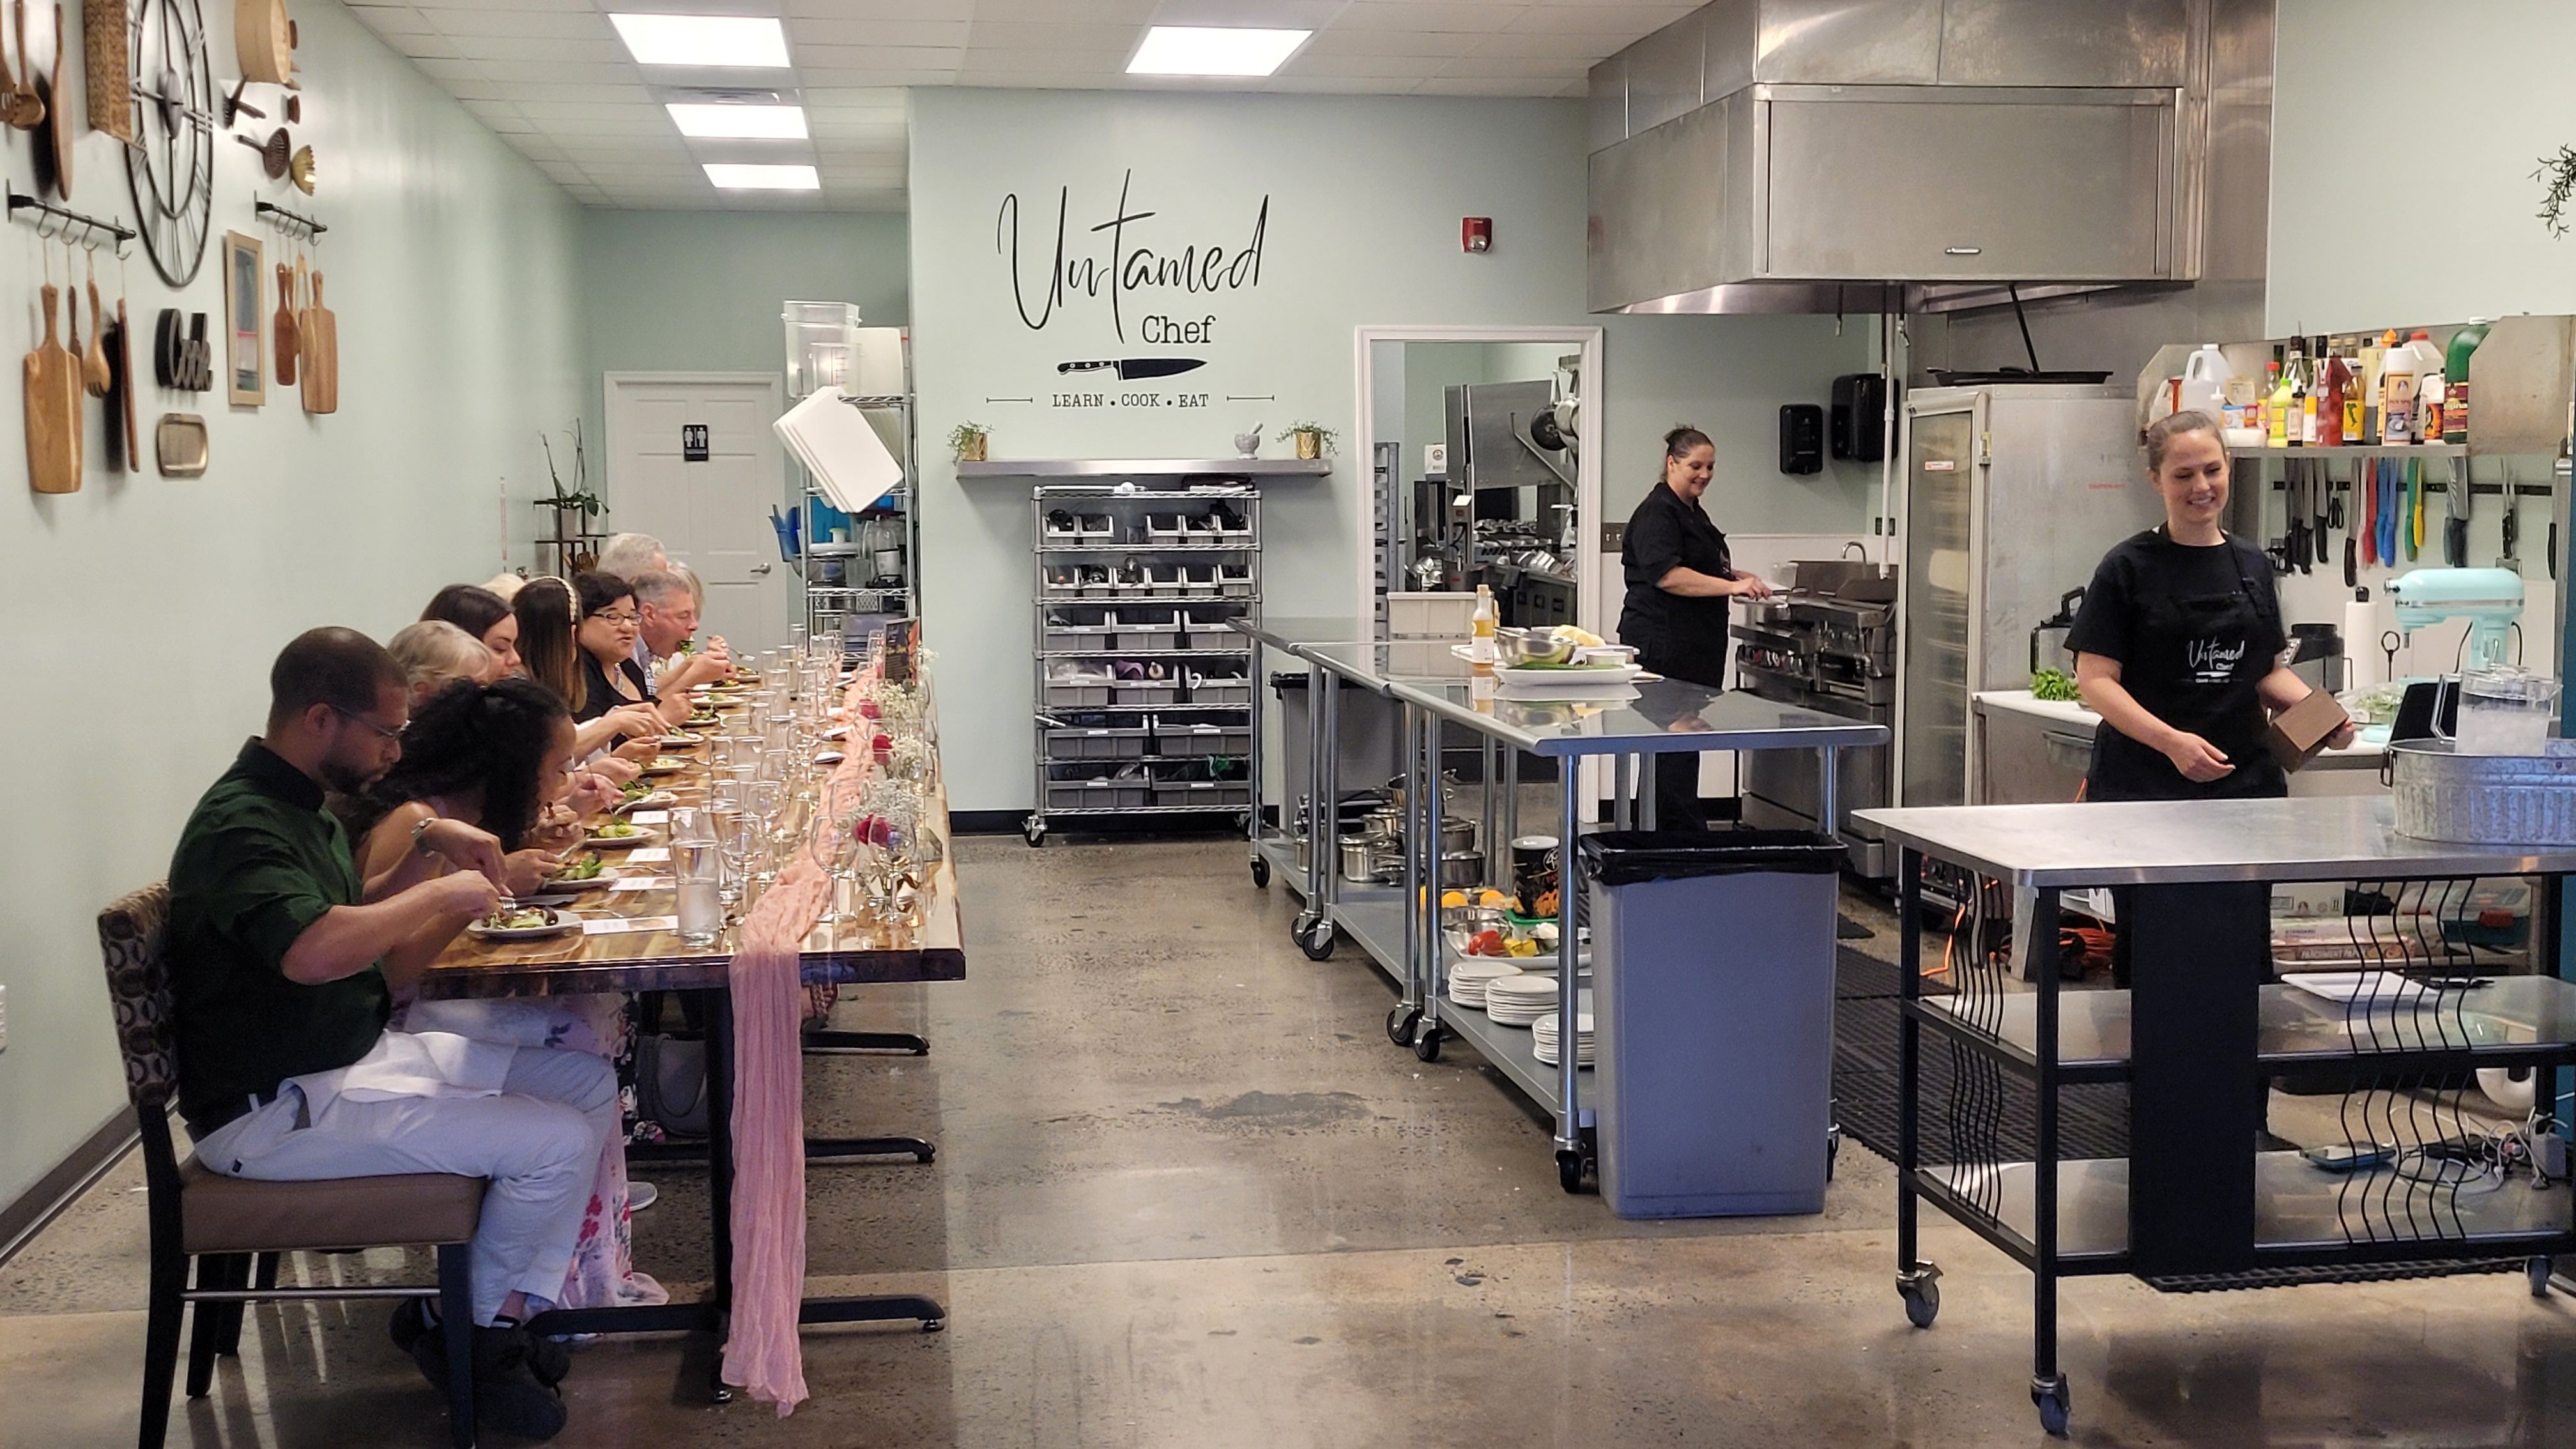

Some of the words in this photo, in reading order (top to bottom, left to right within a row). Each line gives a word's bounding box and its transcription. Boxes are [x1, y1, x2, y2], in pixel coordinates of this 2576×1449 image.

[997, 168, 1269, 344] Untamed
[1142, 314, 1216, 344] Chef
[1052, 394, 1104, 408] LEARN
[1121, 393, 1161, 408] COOK
[1177, 393, 1209, 408] EAT
